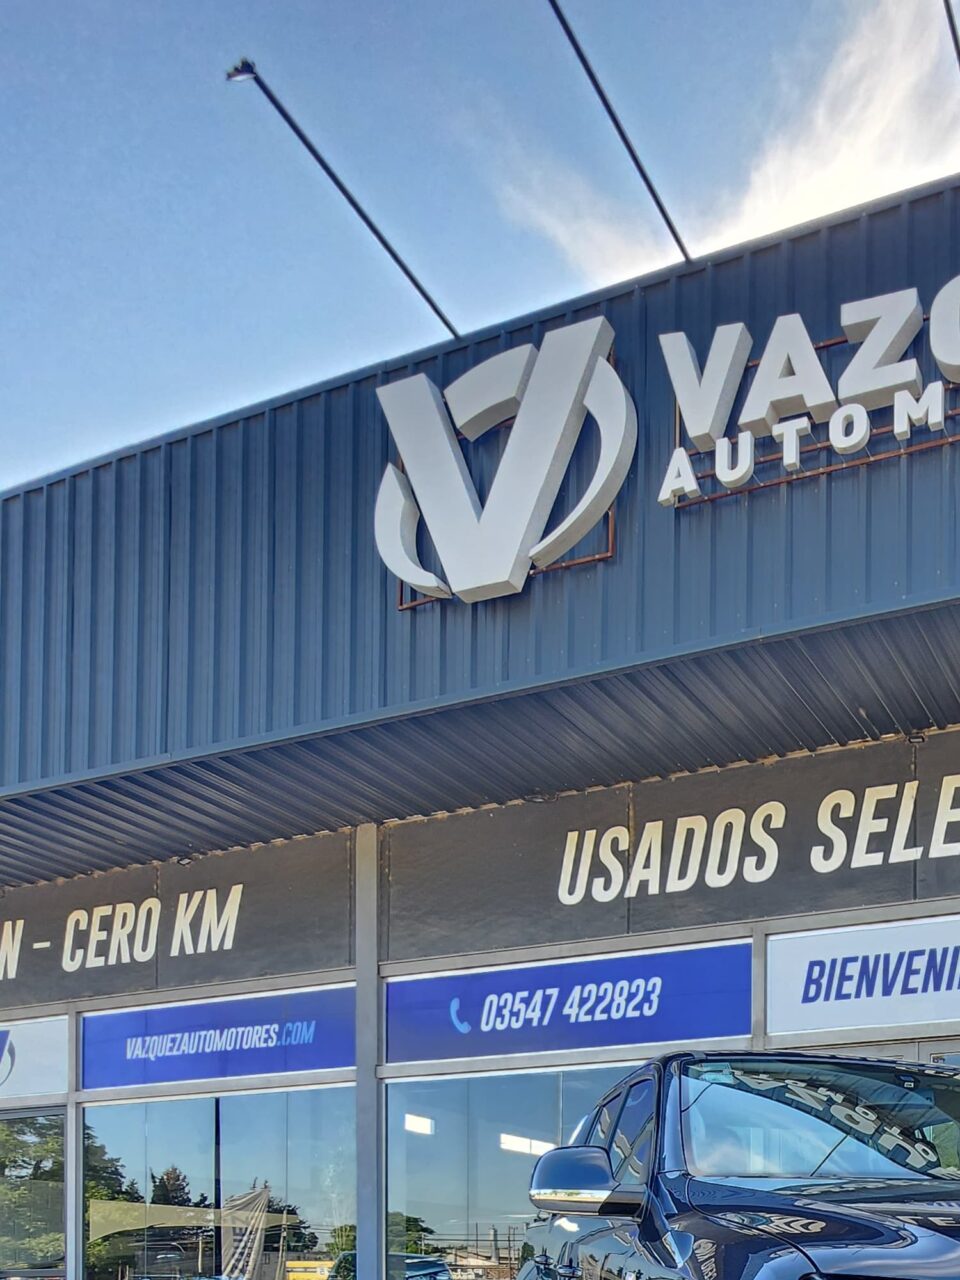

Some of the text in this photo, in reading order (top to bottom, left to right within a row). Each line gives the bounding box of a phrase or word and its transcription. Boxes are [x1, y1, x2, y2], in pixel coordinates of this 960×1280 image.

[558, 801, 785, 906] USADOS
[62, 898, 161, 973] CERO
[170, 884, 244, 957] KM
[480, 976, 662, 1032] 03547 422823
[126, 1020, 316, 1061] VAZQUEZAUTOMOTORES.COM
